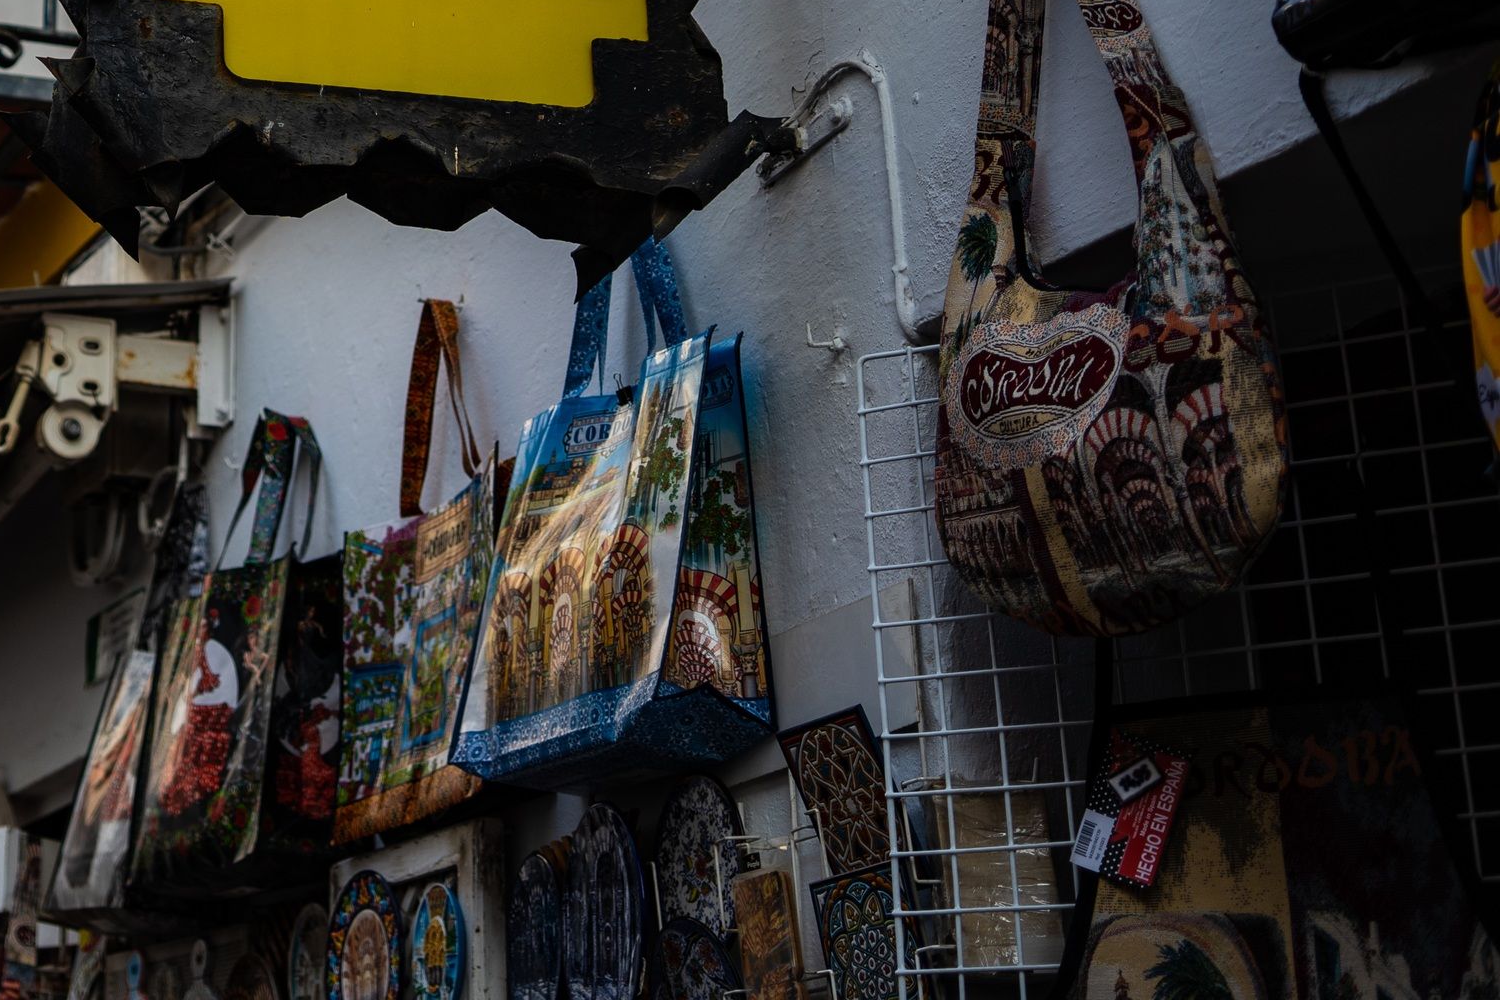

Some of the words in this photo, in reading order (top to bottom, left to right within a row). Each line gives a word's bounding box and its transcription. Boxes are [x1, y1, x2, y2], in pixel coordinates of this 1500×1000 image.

[998, 415, 1039, 433] CULTURA
[1157, 760, 1187, 812] ESPAÑA
[1151, 812, 1171, 835] EN
[1135, 836, 1162, 881] HECHO
